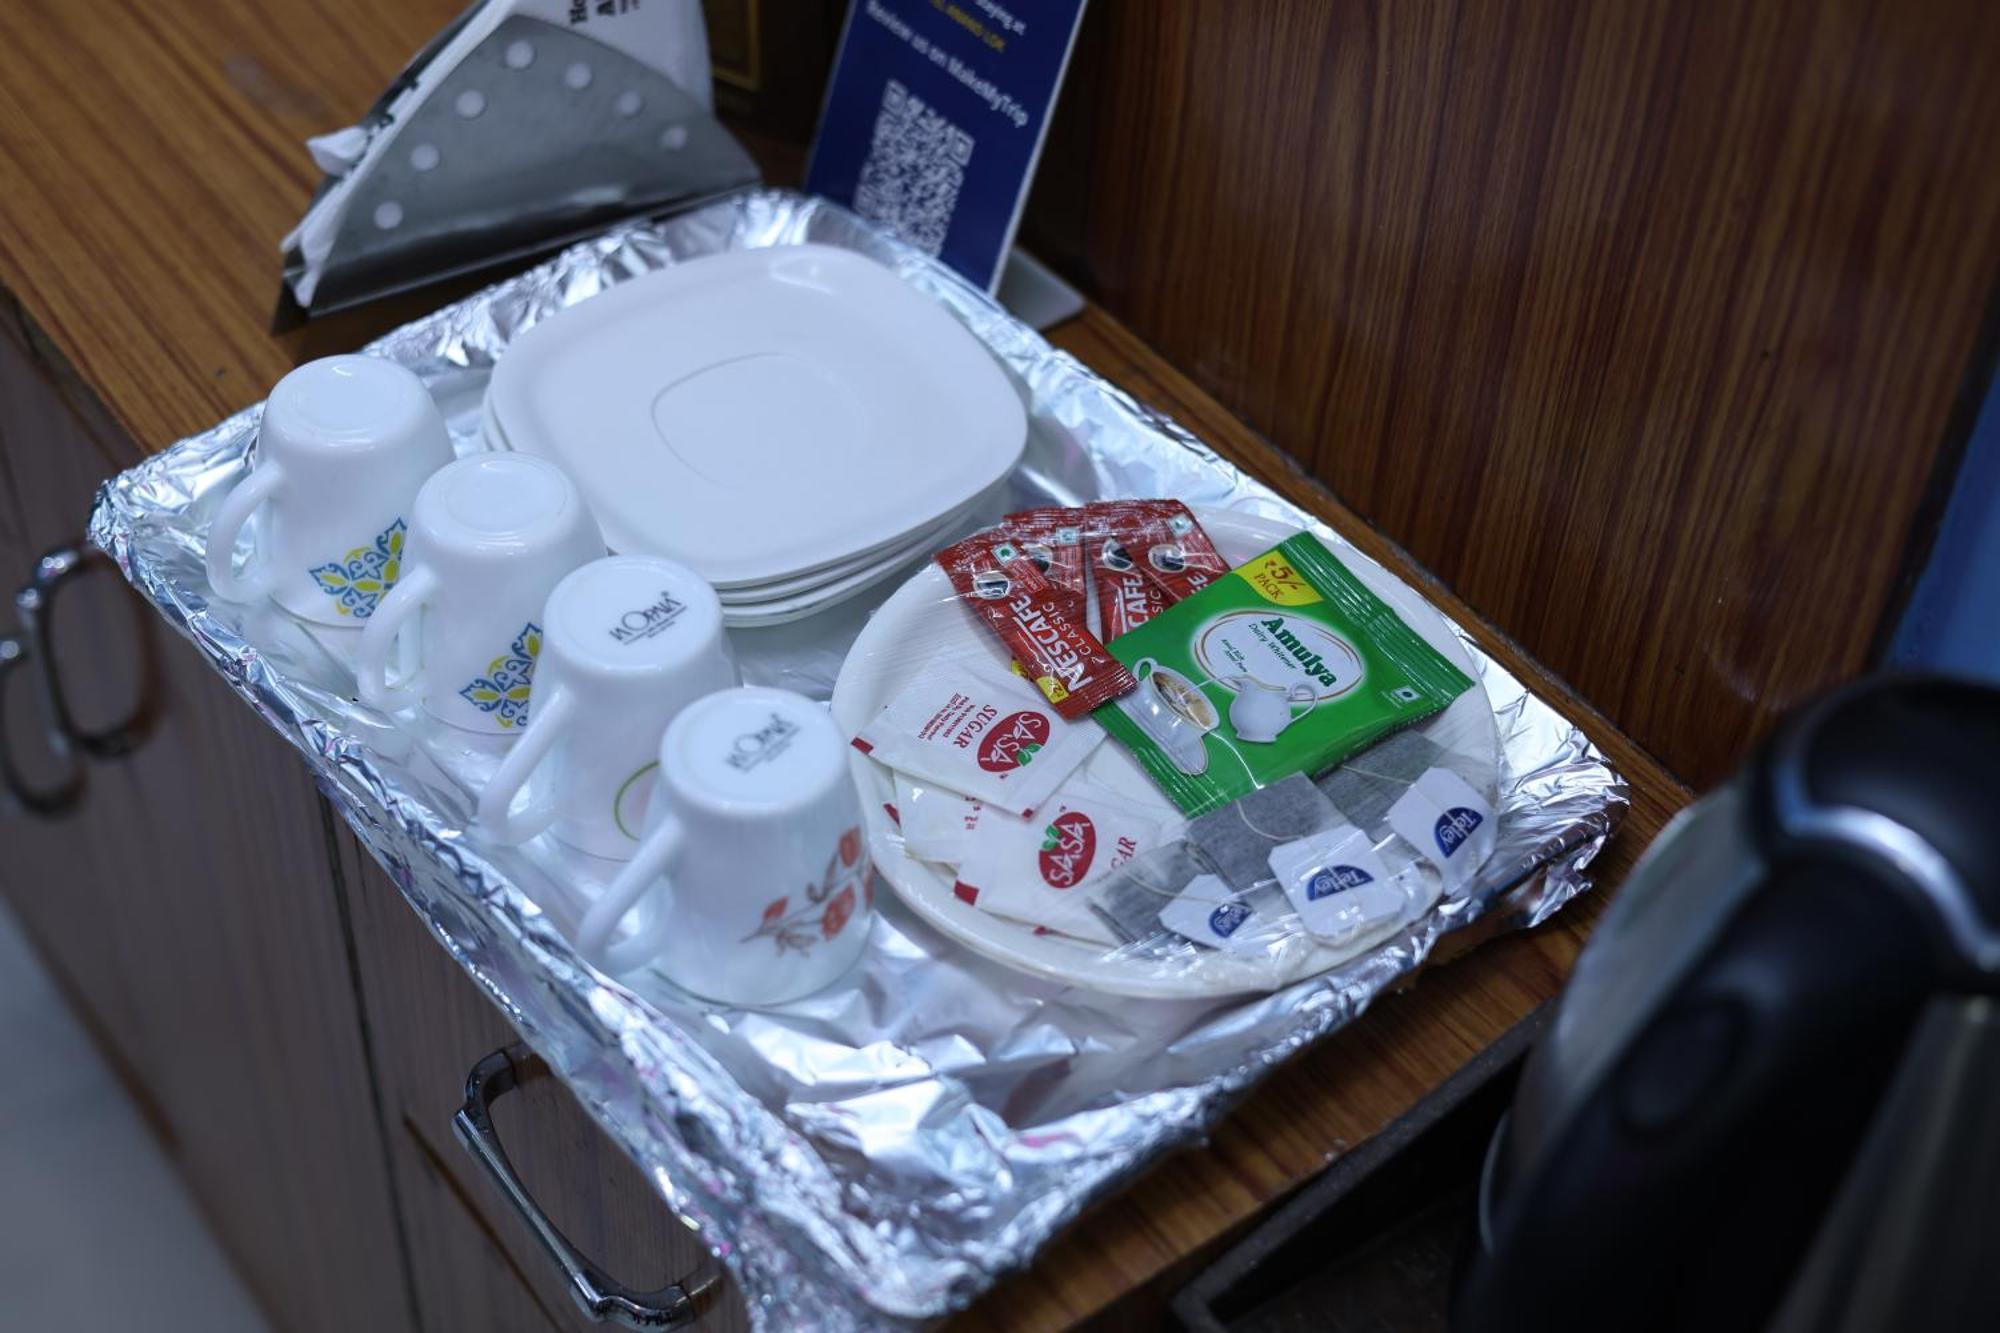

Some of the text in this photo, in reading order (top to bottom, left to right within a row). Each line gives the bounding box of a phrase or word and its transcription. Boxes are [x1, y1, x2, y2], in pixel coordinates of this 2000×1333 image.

[948, 57, 1028, 128] MakeMyTrip
[1122, 575, 1150, 628] CAFE
[1254, 572, 1284, 600] PACK
[1042, 600, 1092, 658] CLASSIC
[1248, 622, 1297, 671] Dairy Whitener
[1261, 617, 1338, 688] Amulya
[953, 704, 998, 749] SUGAR
[980, 711, 1041, 764] SASA
[1050, 821, 1090, 886] SASA
[1438, 810, 1479, 848] Tetley
[1311, 869, 1366, 896] Tetley
